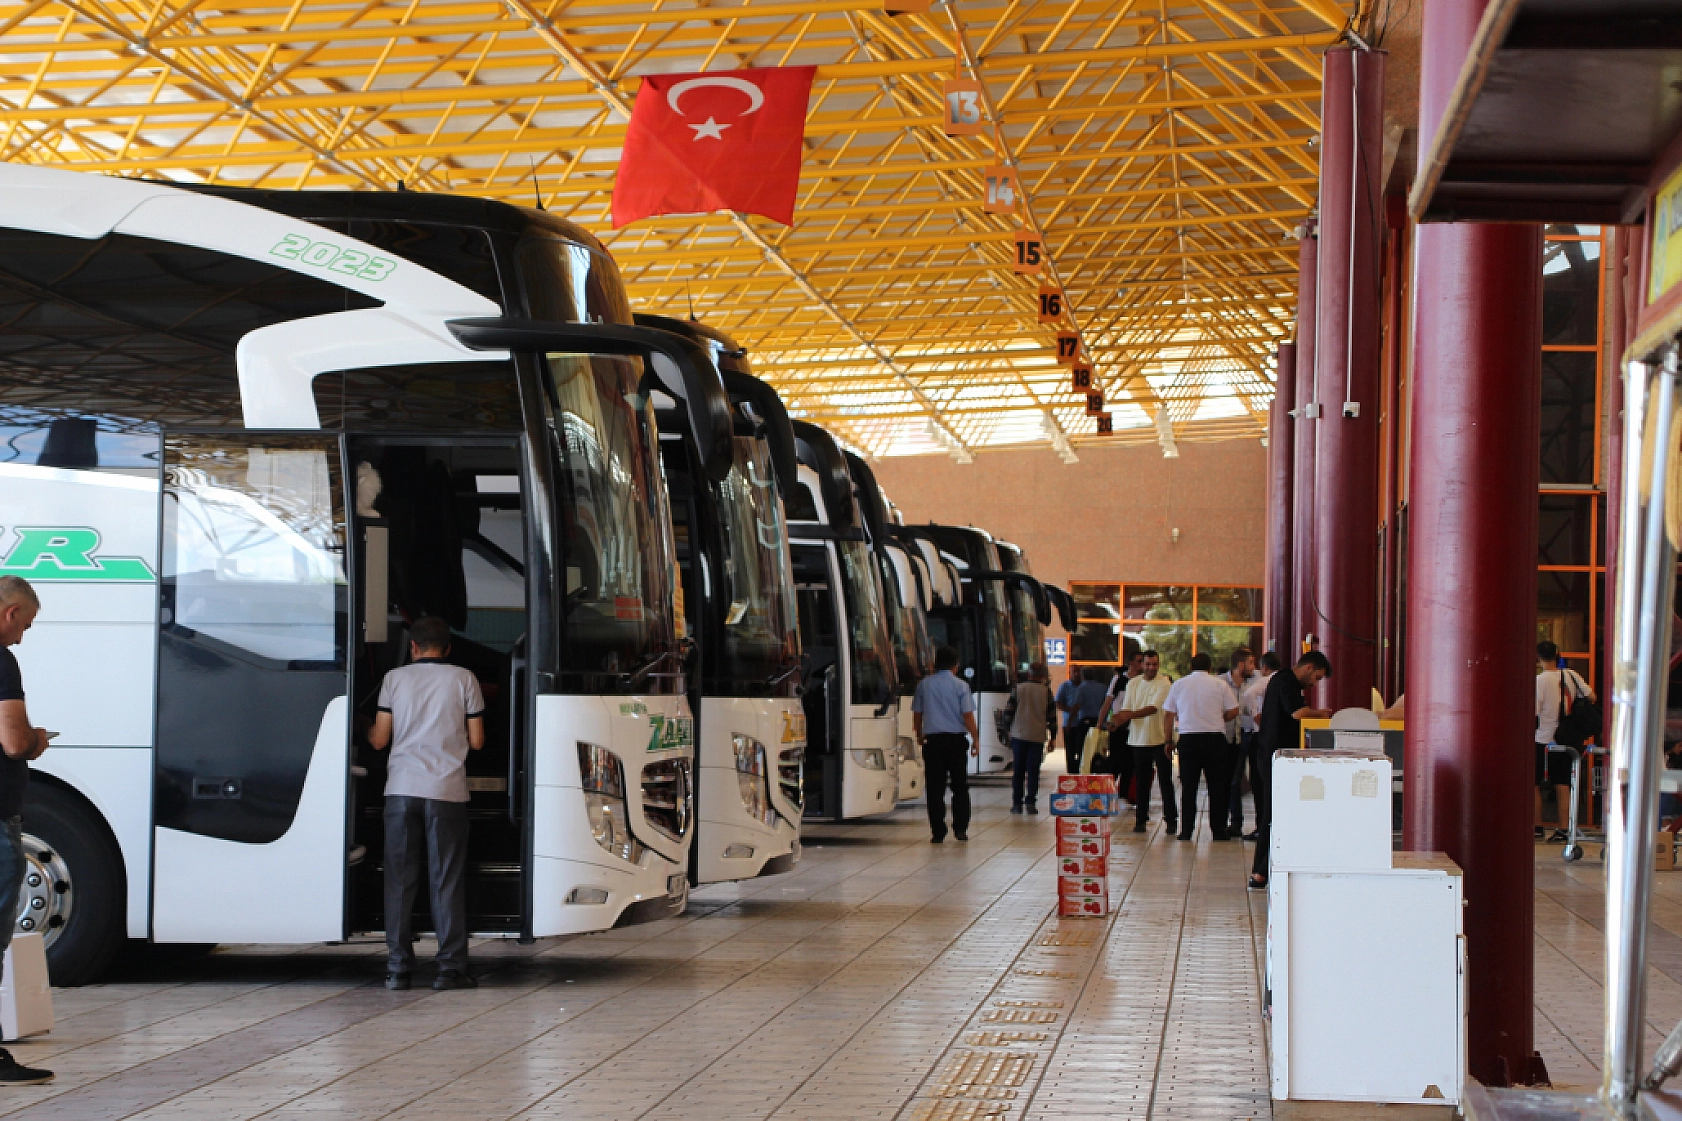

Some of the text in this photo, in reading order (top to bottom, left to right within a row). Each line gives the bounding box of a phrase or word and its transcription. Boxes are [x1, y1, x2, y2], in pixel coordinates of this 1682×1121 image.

[947, 91, 980, 124] 13
[986, 176, 1014, 206] 14
[268, 233, 398, 282] 2023
[1016, 241, 1041, 265] 15
[1040, 294, 1060, 315] 16
[1058, 338, 1077, 356] 17
[1073, 369, 1090, 386] 18
[1088, 395, 1102, 411] 19
